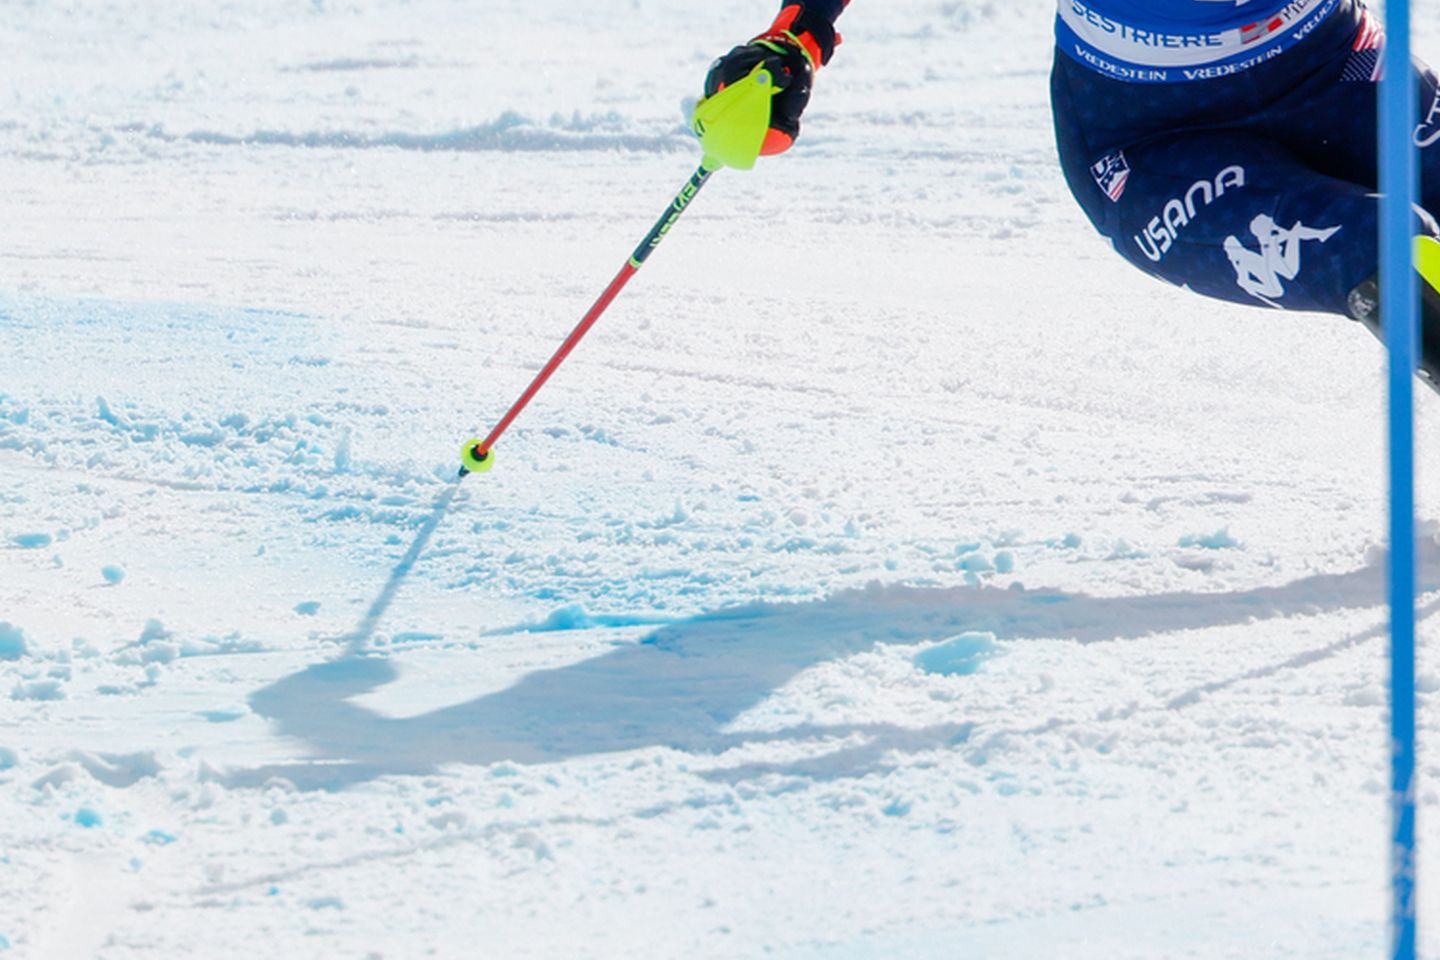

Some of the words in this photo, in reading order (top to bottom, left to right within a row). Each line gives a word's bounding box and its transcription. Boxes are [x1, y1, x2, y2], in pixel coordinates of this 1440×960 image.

[1074, 44, 1168, 81] VREDESTEIN
[1184, 45, 1283, 81] VREDESTEIN
[1134, 165, 1245, 262] USANA
